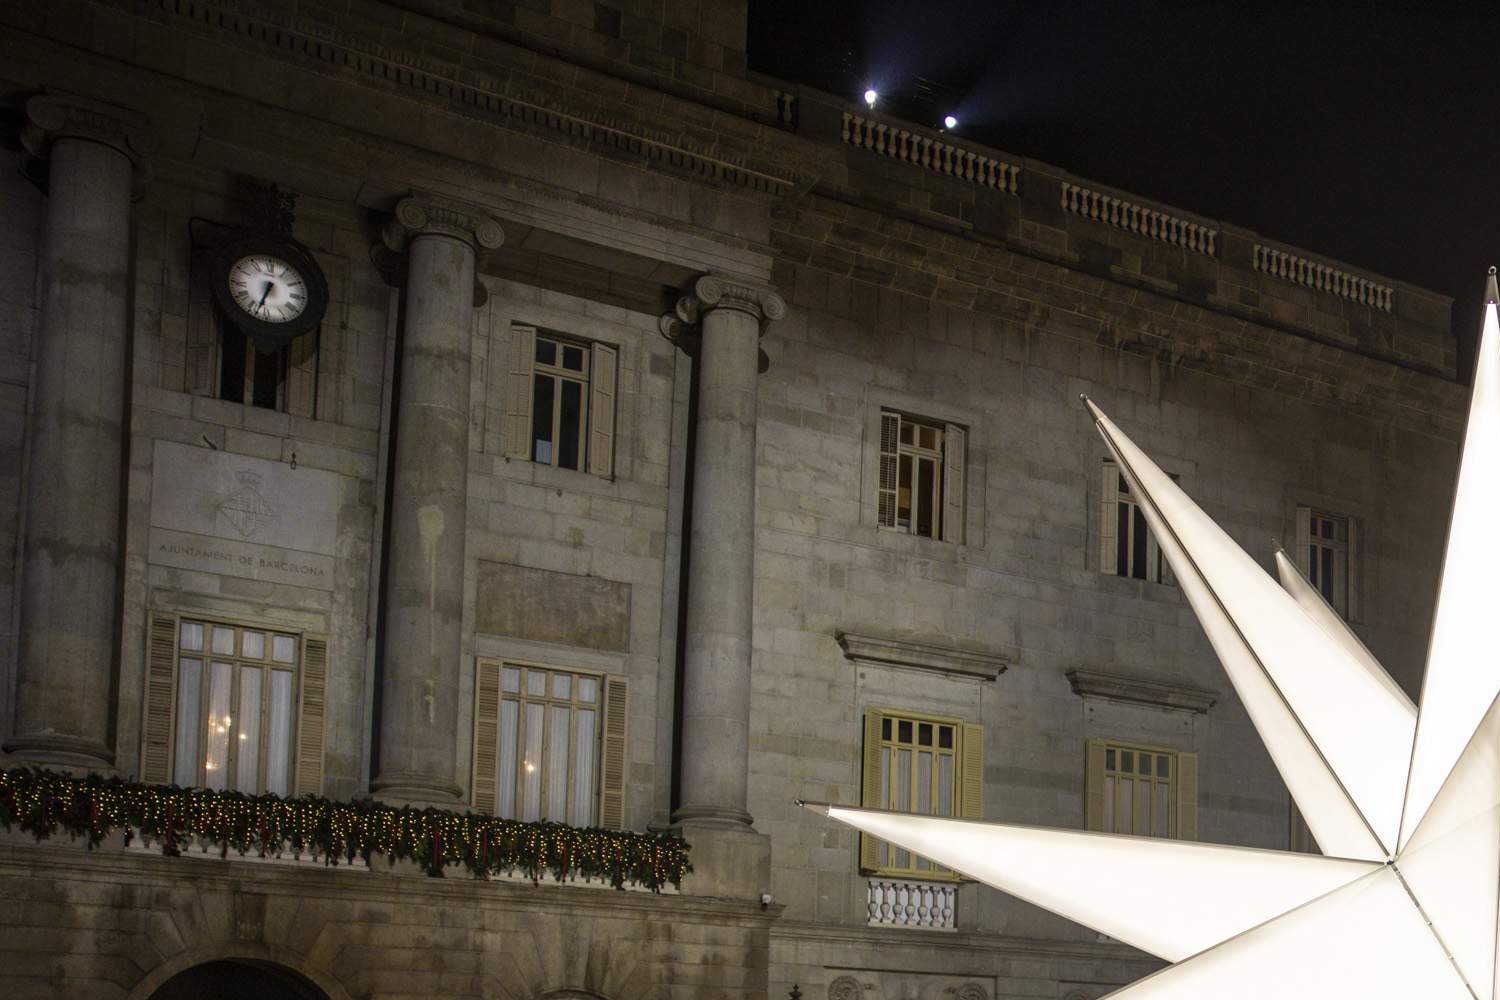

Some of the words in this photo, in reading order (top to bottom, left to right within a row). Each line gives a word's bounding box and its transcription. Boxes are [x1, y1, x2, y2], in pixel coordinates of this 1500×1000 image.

[159, 544, 233, 562] AJUNTAMENT
[239, 554, 253, 566] DE
[259, 559, 326, 577] BARCELONA
